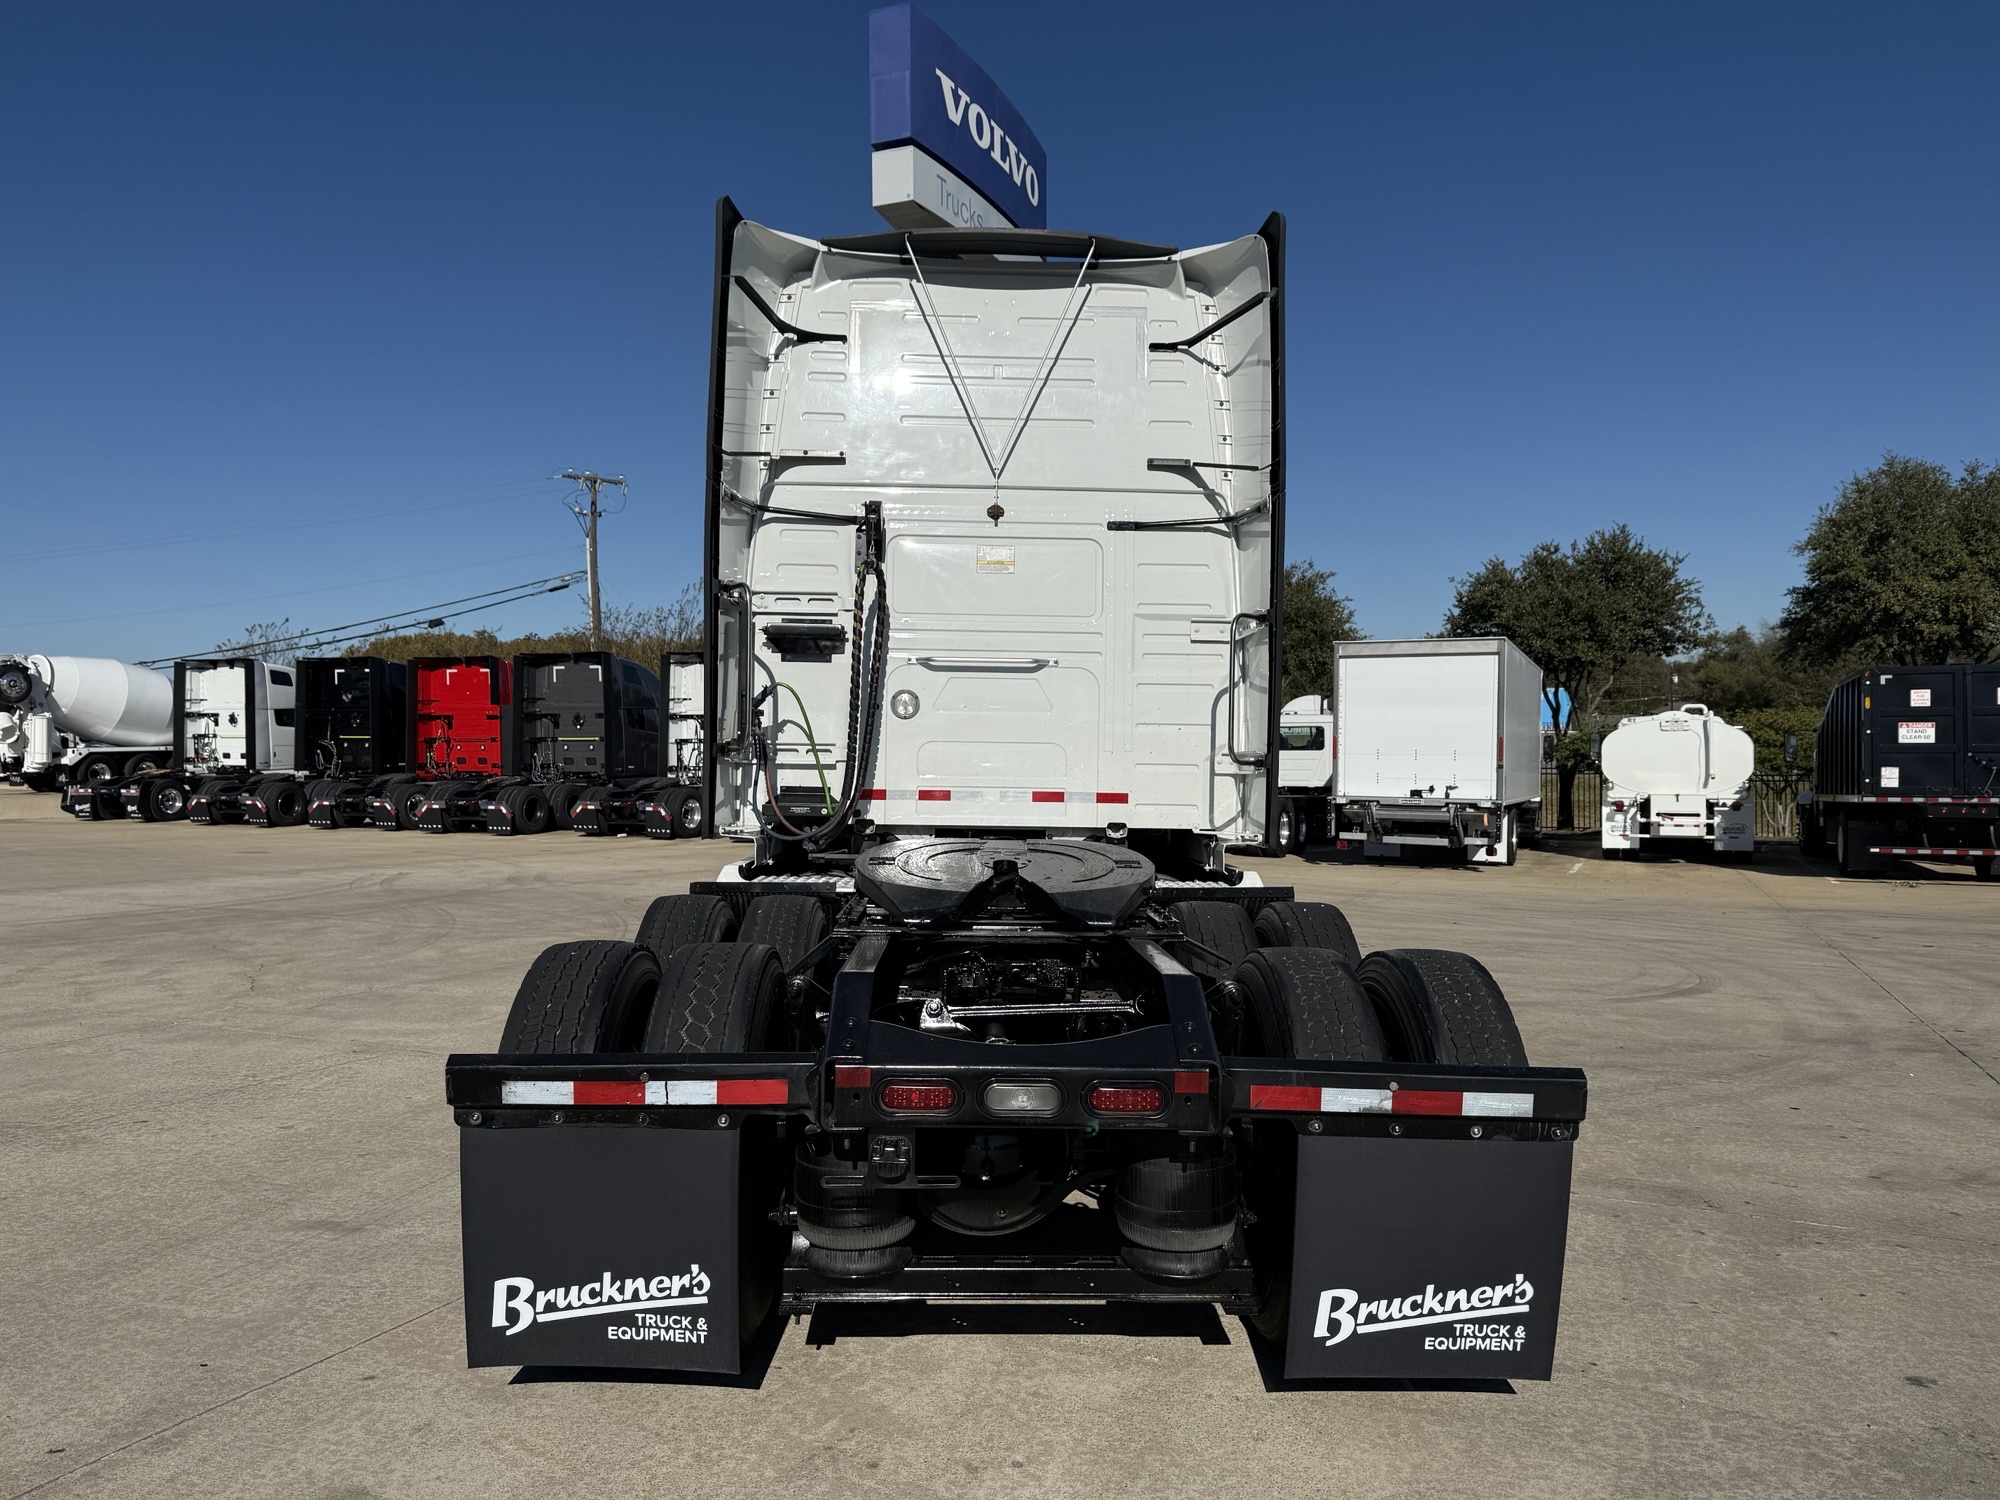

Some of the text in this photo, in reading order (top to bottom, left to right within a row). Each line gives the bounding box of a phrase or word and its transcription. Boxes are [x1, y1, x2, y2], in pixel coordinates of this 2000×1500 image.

[935, 67, 1039, 208] VOLVO
[936, 174, 984, 228] Trucks
[491, 1263, 711, 1336] Bruckner's
[1313, 1273, 1534, 1347] Bruckner's
[607, 1326, 708, 1344] EQUIPMENT
[635, 1313, 708, 1331] TRUCK &
[1453, 1323, 1526, 1339] TRUCK &
[1424, 1337, 1525, 1352] EQUIPMENT
